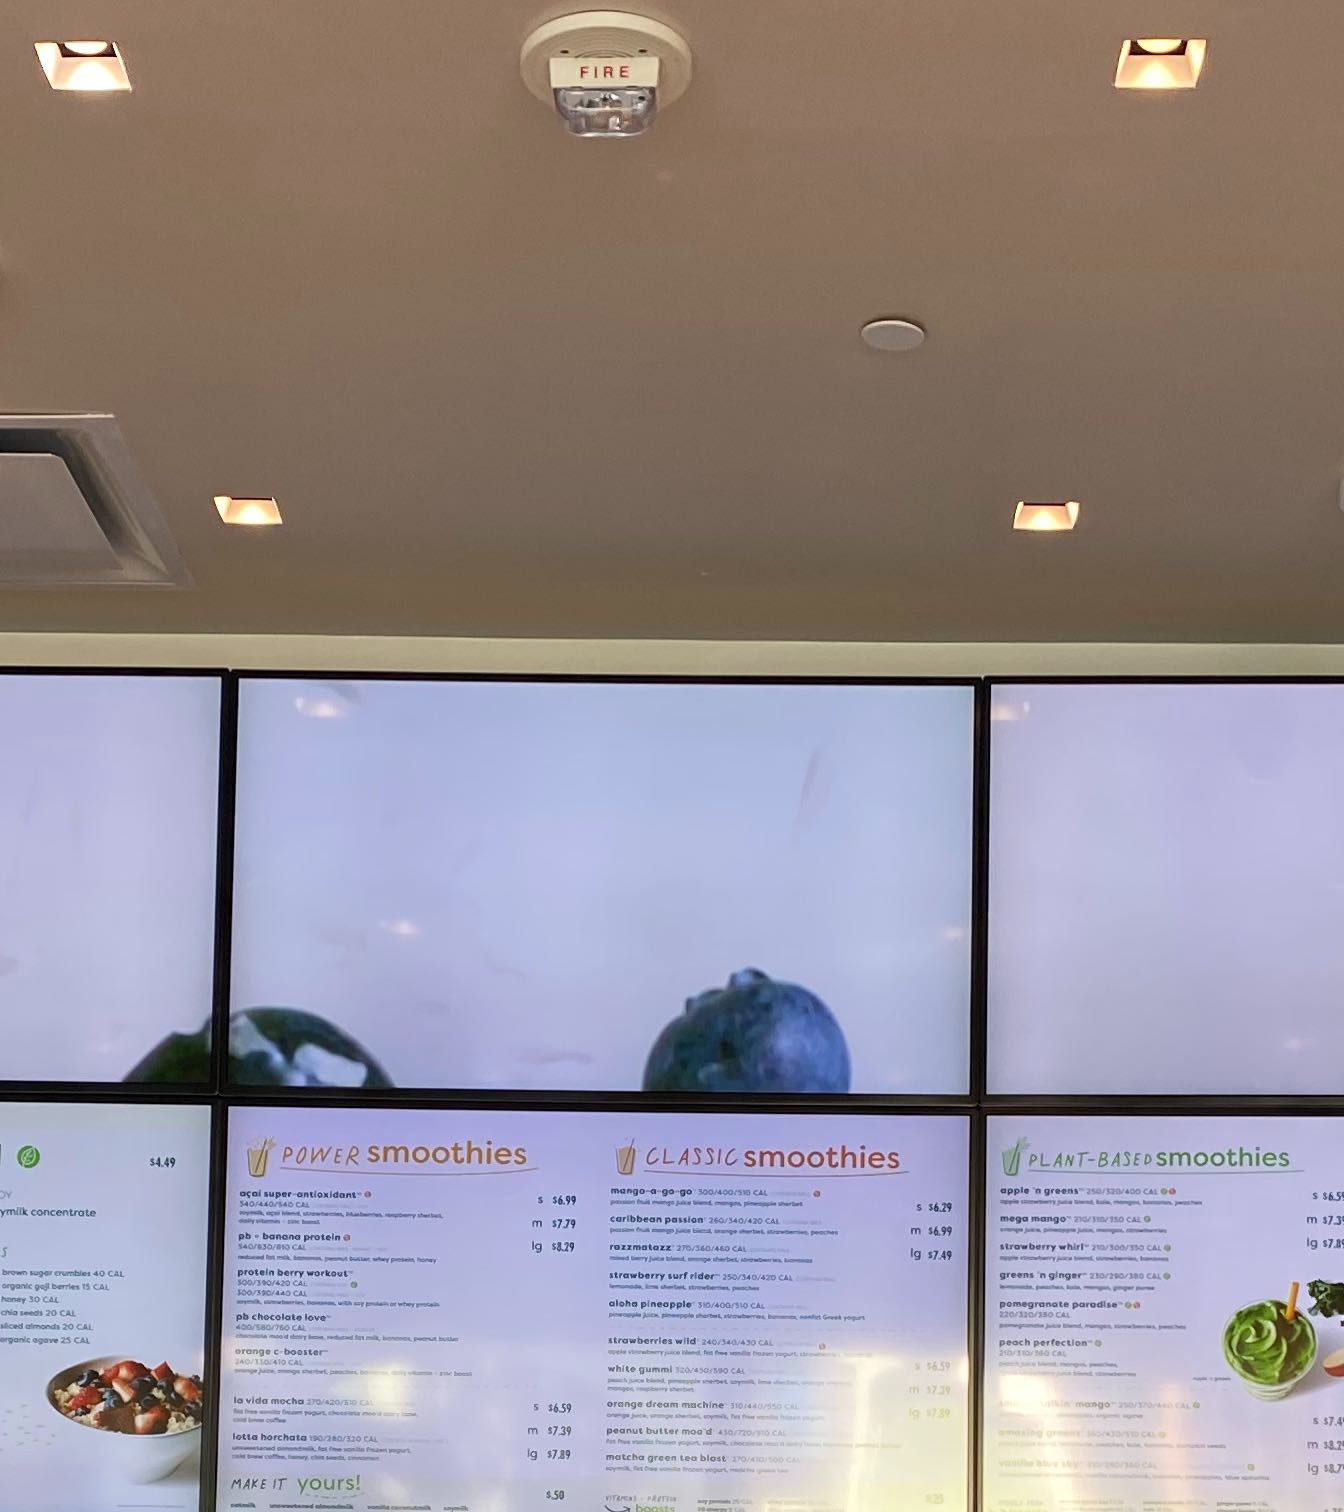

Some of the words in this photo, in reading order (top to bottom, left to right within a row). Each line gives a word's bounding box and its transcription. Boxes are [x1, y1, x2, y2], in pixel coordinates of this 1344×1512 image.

[580, 66, 631, 79] FIRE
[281, 1146, 360, 1166] POWER
[367, 1140, 528, 1165] smoothies
[646, 1147, 739, 1167] CLASSIC
[744, 1145, 900, 1169] smoothies
[1028, 1151, 1152, 1168] PLANT-BASED
[1156, 1146, 1290, 1168] smoothies
[149, 1157, 176, 1169] $4.49
[552, 1195, 577, 1206] $6.99
[30, 1208, 97, 1218] concentrate
[928, 1202, 953, 1213] $6.29
[532, 1219, 543, 1228] m
[552, 1218, 577, 1230] $7.79
[609, 1215, 663, 1225] caribbean
[1306, 1216, 1318, 1224] m
[910, 1227, 921, 1235] m
[928, 1225, 953, 1237] $6.99
[238, 1233, 252, 1242] pb
[262, 1233, 301, 1241] banana
[303, 1233, 341, 1243] protein
[551, 1241, 575, 1253] $8.29
[927, 1249, 953, 1261] $7.49
[237, 1268, 275, 1278] protein
[277, 1269, 305, 1278] berry
[609, 1271, 665, 1283] strawberry
[667, 1271, 688, 1281] surf
[42, 1296, 59, 1304] CAL
[608, 1299, 638, 1308] aloha
[607, 1365, 636, 1374] white
[638, 1365, 673, 1376] gummi
[233, 1396, 244, 1405] la
[245, 1396, 269, 1406] vida
[271, 1397, 305, 1406] mocha
[548, 1403, 572, 1414] $6.59
[527, 1427, 538, 1435] m
[547, 1425, 572, 1437] $7.39
[232, 1432, 258, 1442] lotta
[260, 1432, 307, 1442] horchata
[1307, 1441, 1318, 1449] m
[547, 1449, 571, 1460] $7.89
[230, 1478, 267, 1491] MAKE
[272, 1478, 287, 1490] IT
[297, 1475, 361, 1495] yours!
[546, 1489, 565, 1501] $.50
